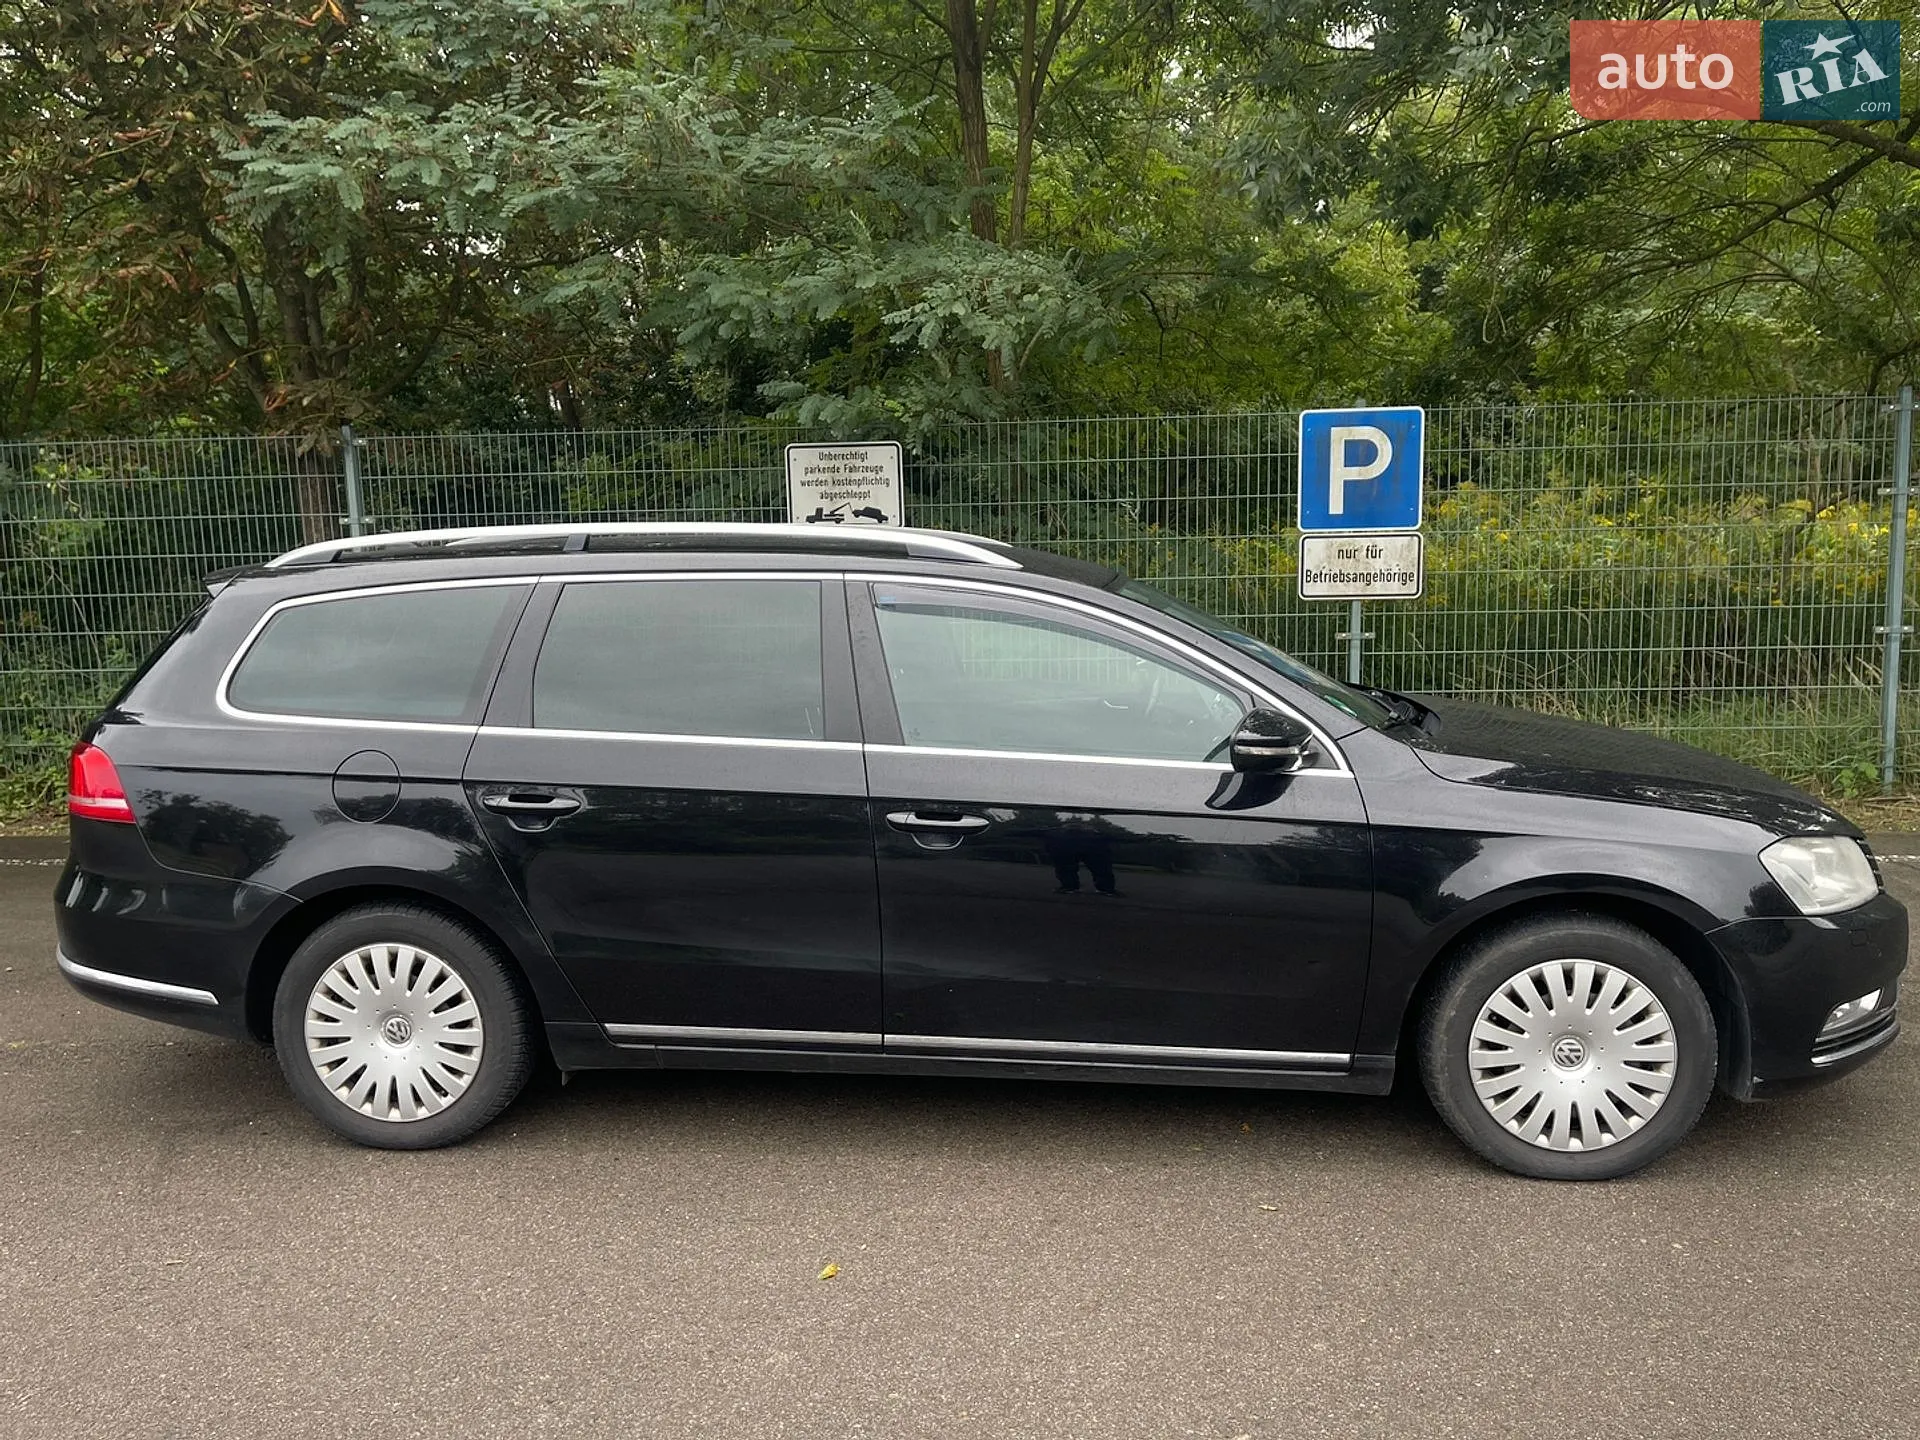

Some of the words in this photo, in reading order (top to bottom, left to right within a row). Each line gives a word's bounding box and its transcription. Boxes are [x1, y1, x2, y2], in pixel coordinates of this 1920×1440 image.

[818, 451, 868, 462] Unberechtigt
[804, 464, 840, 476] parkende
[844, 464, 884, 475] Fahrzeuge
[1329, 426, 1393, 515] P
[800, 478, 829, 487] werden
[832, 476, 890, 488] kostenpflichtig
[1337, 549, 1358, 560] nur
[1365, 544, 1384, 559] für
[1305, 567, 1415, 586] Betriebsangehörige
